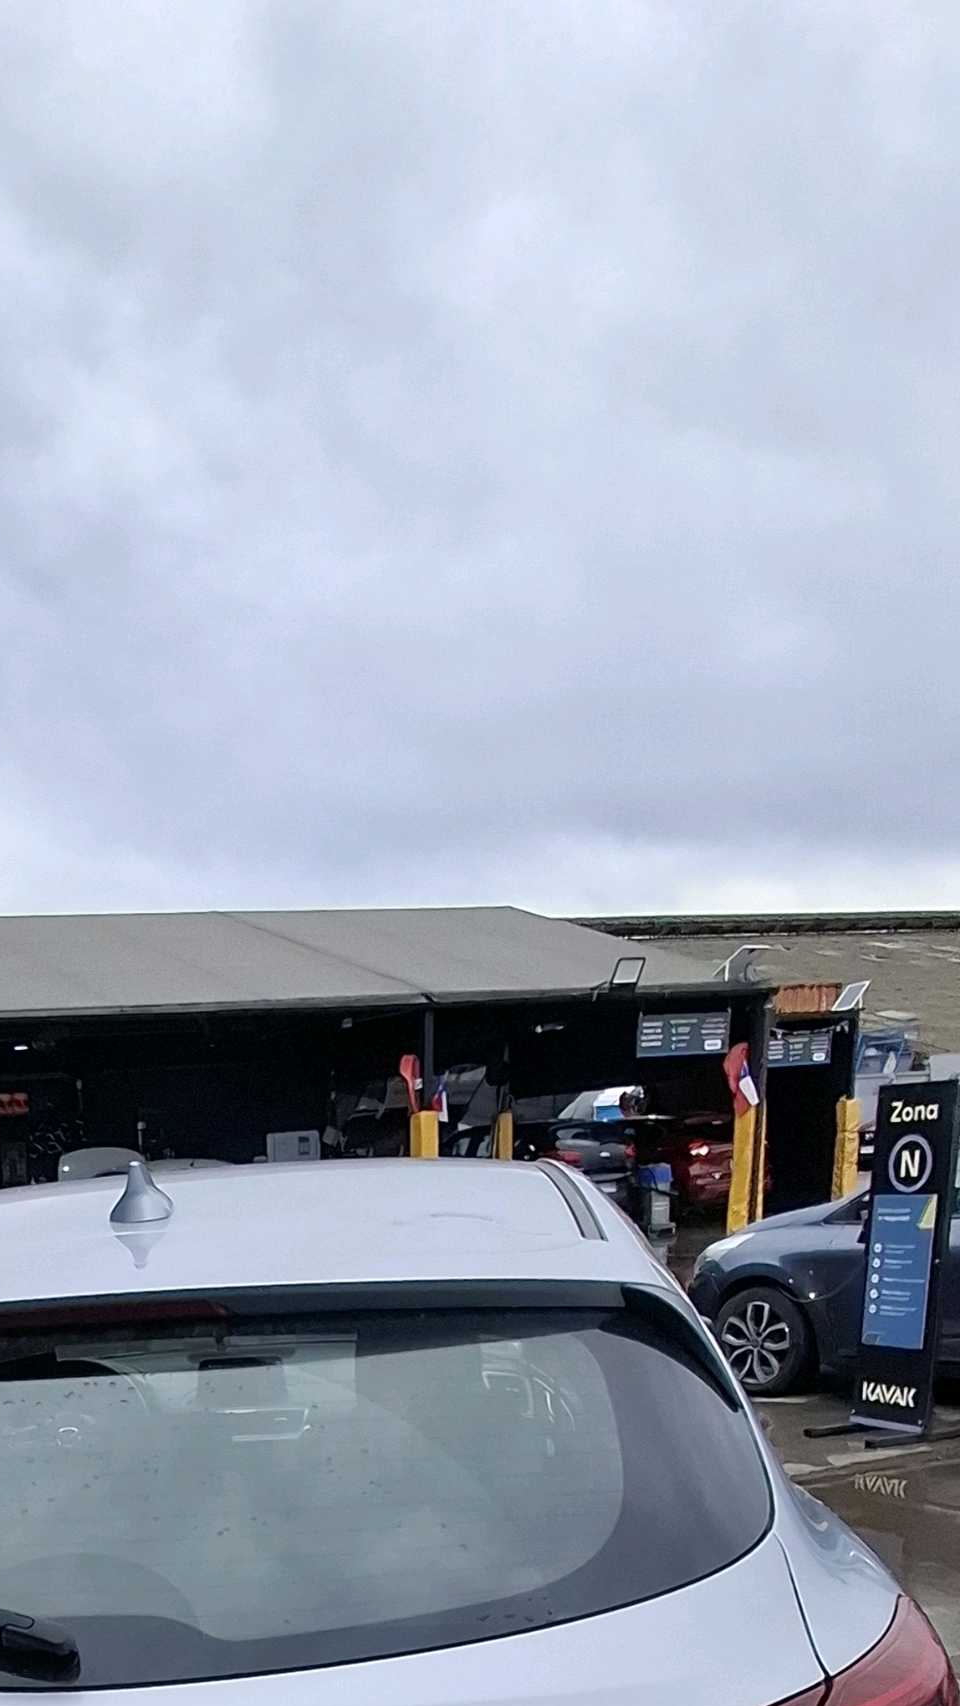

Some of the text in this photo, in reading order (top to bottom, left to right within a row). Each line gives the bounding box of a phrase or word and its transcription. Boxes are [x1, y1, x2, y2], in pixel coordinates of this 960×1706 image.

[890, 1100, 939, 1123] Zona
[900, 1149, 920, 1178] N
[862, 1381, 917, 1408] KAVAK
